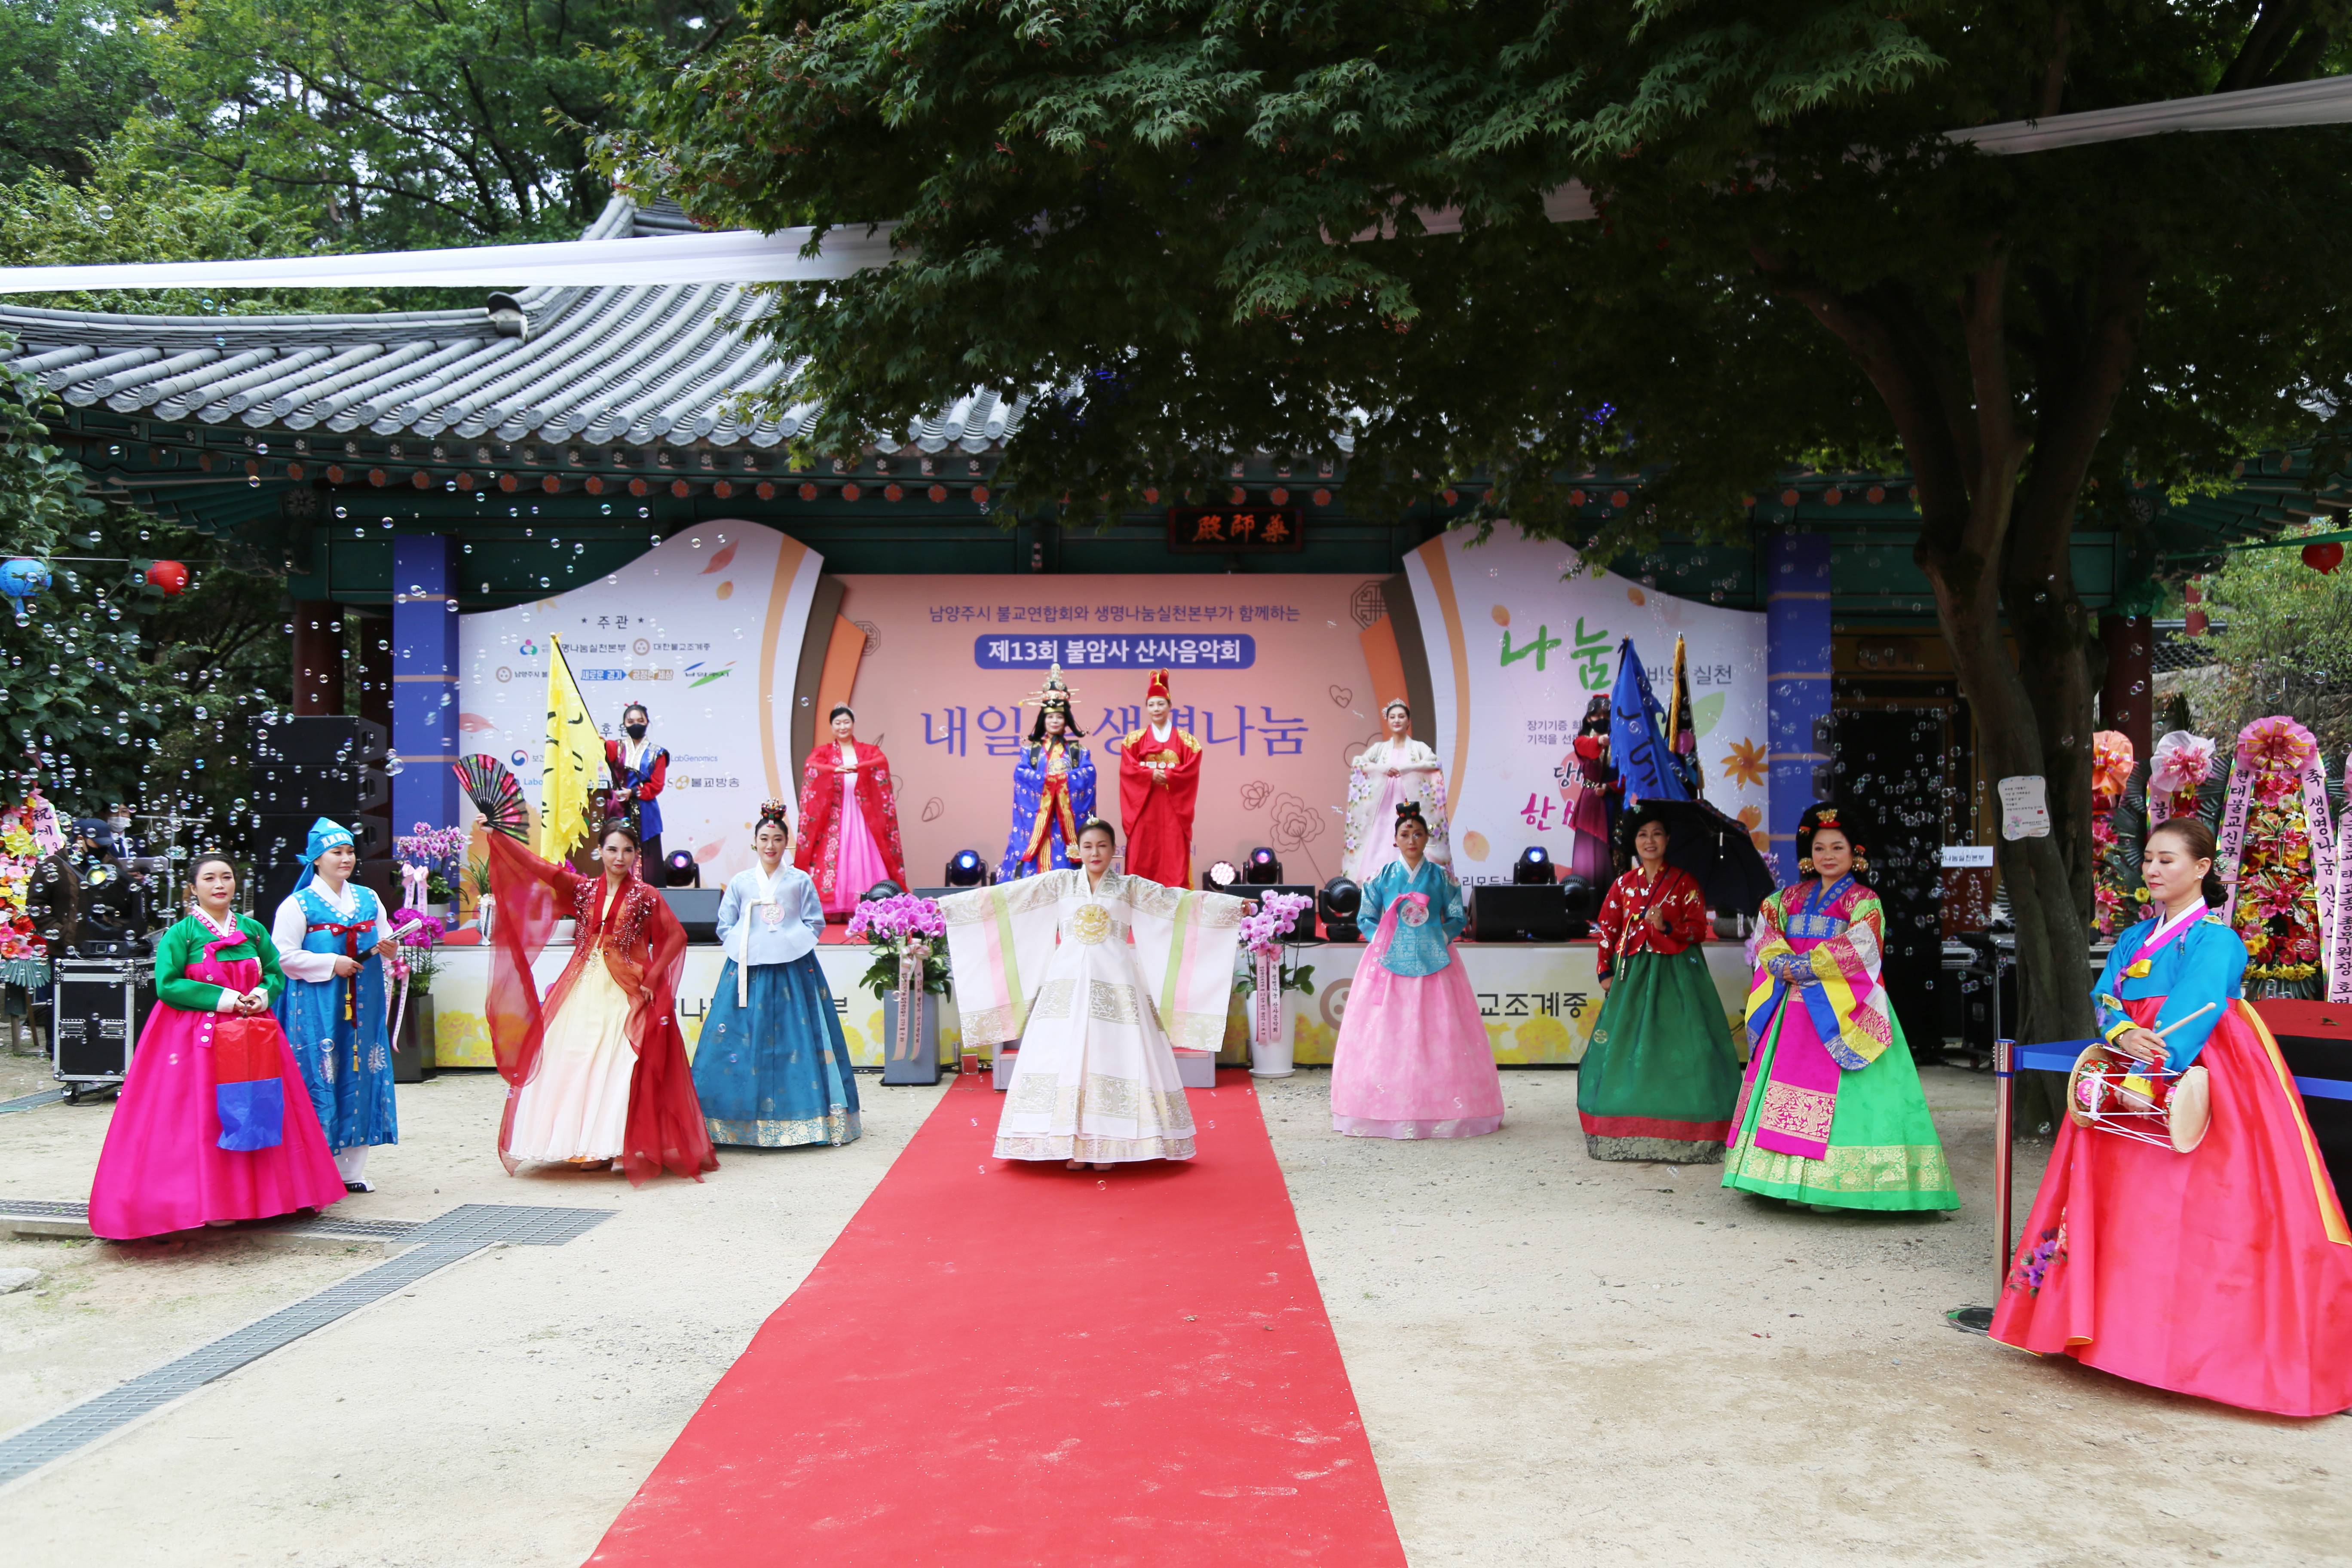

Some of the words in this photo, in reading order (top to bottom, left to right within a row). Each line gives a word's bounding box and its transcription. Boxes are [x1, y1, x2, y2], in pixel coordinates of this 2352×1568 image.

[930, 605, 990, 622] 남양주시
[996, 605, 1089, 622] 불교연합회와
[1094, 605, 1233, 622] 생명나눔실천본부가
[1239, 605, 1301, 622] 함께하는
[988, 640, 1058, 662] 제13회
[1065, 640, 1130, 663] 불암사
[1135, 639, 1240, 663] 산사음악회
[1500, 616, 1614, 690] 나눔
[581, 670, 603, 680] 새로운
[606, 670, 622, 680] 경기
[658, 670, 673, 680] 세상
[1694, 665, 1732, 685] 실천
[921, 705, 1075, 756] 내일
[1527, 720, 1568, 731] 장기기증
[1528, 734, 1558, 744] 기적을
[692, 778, 739, 787] 불교방송
[2305, 768, 2322, 787] 축
[2309, 794, 2336, 876] 생명나눔
